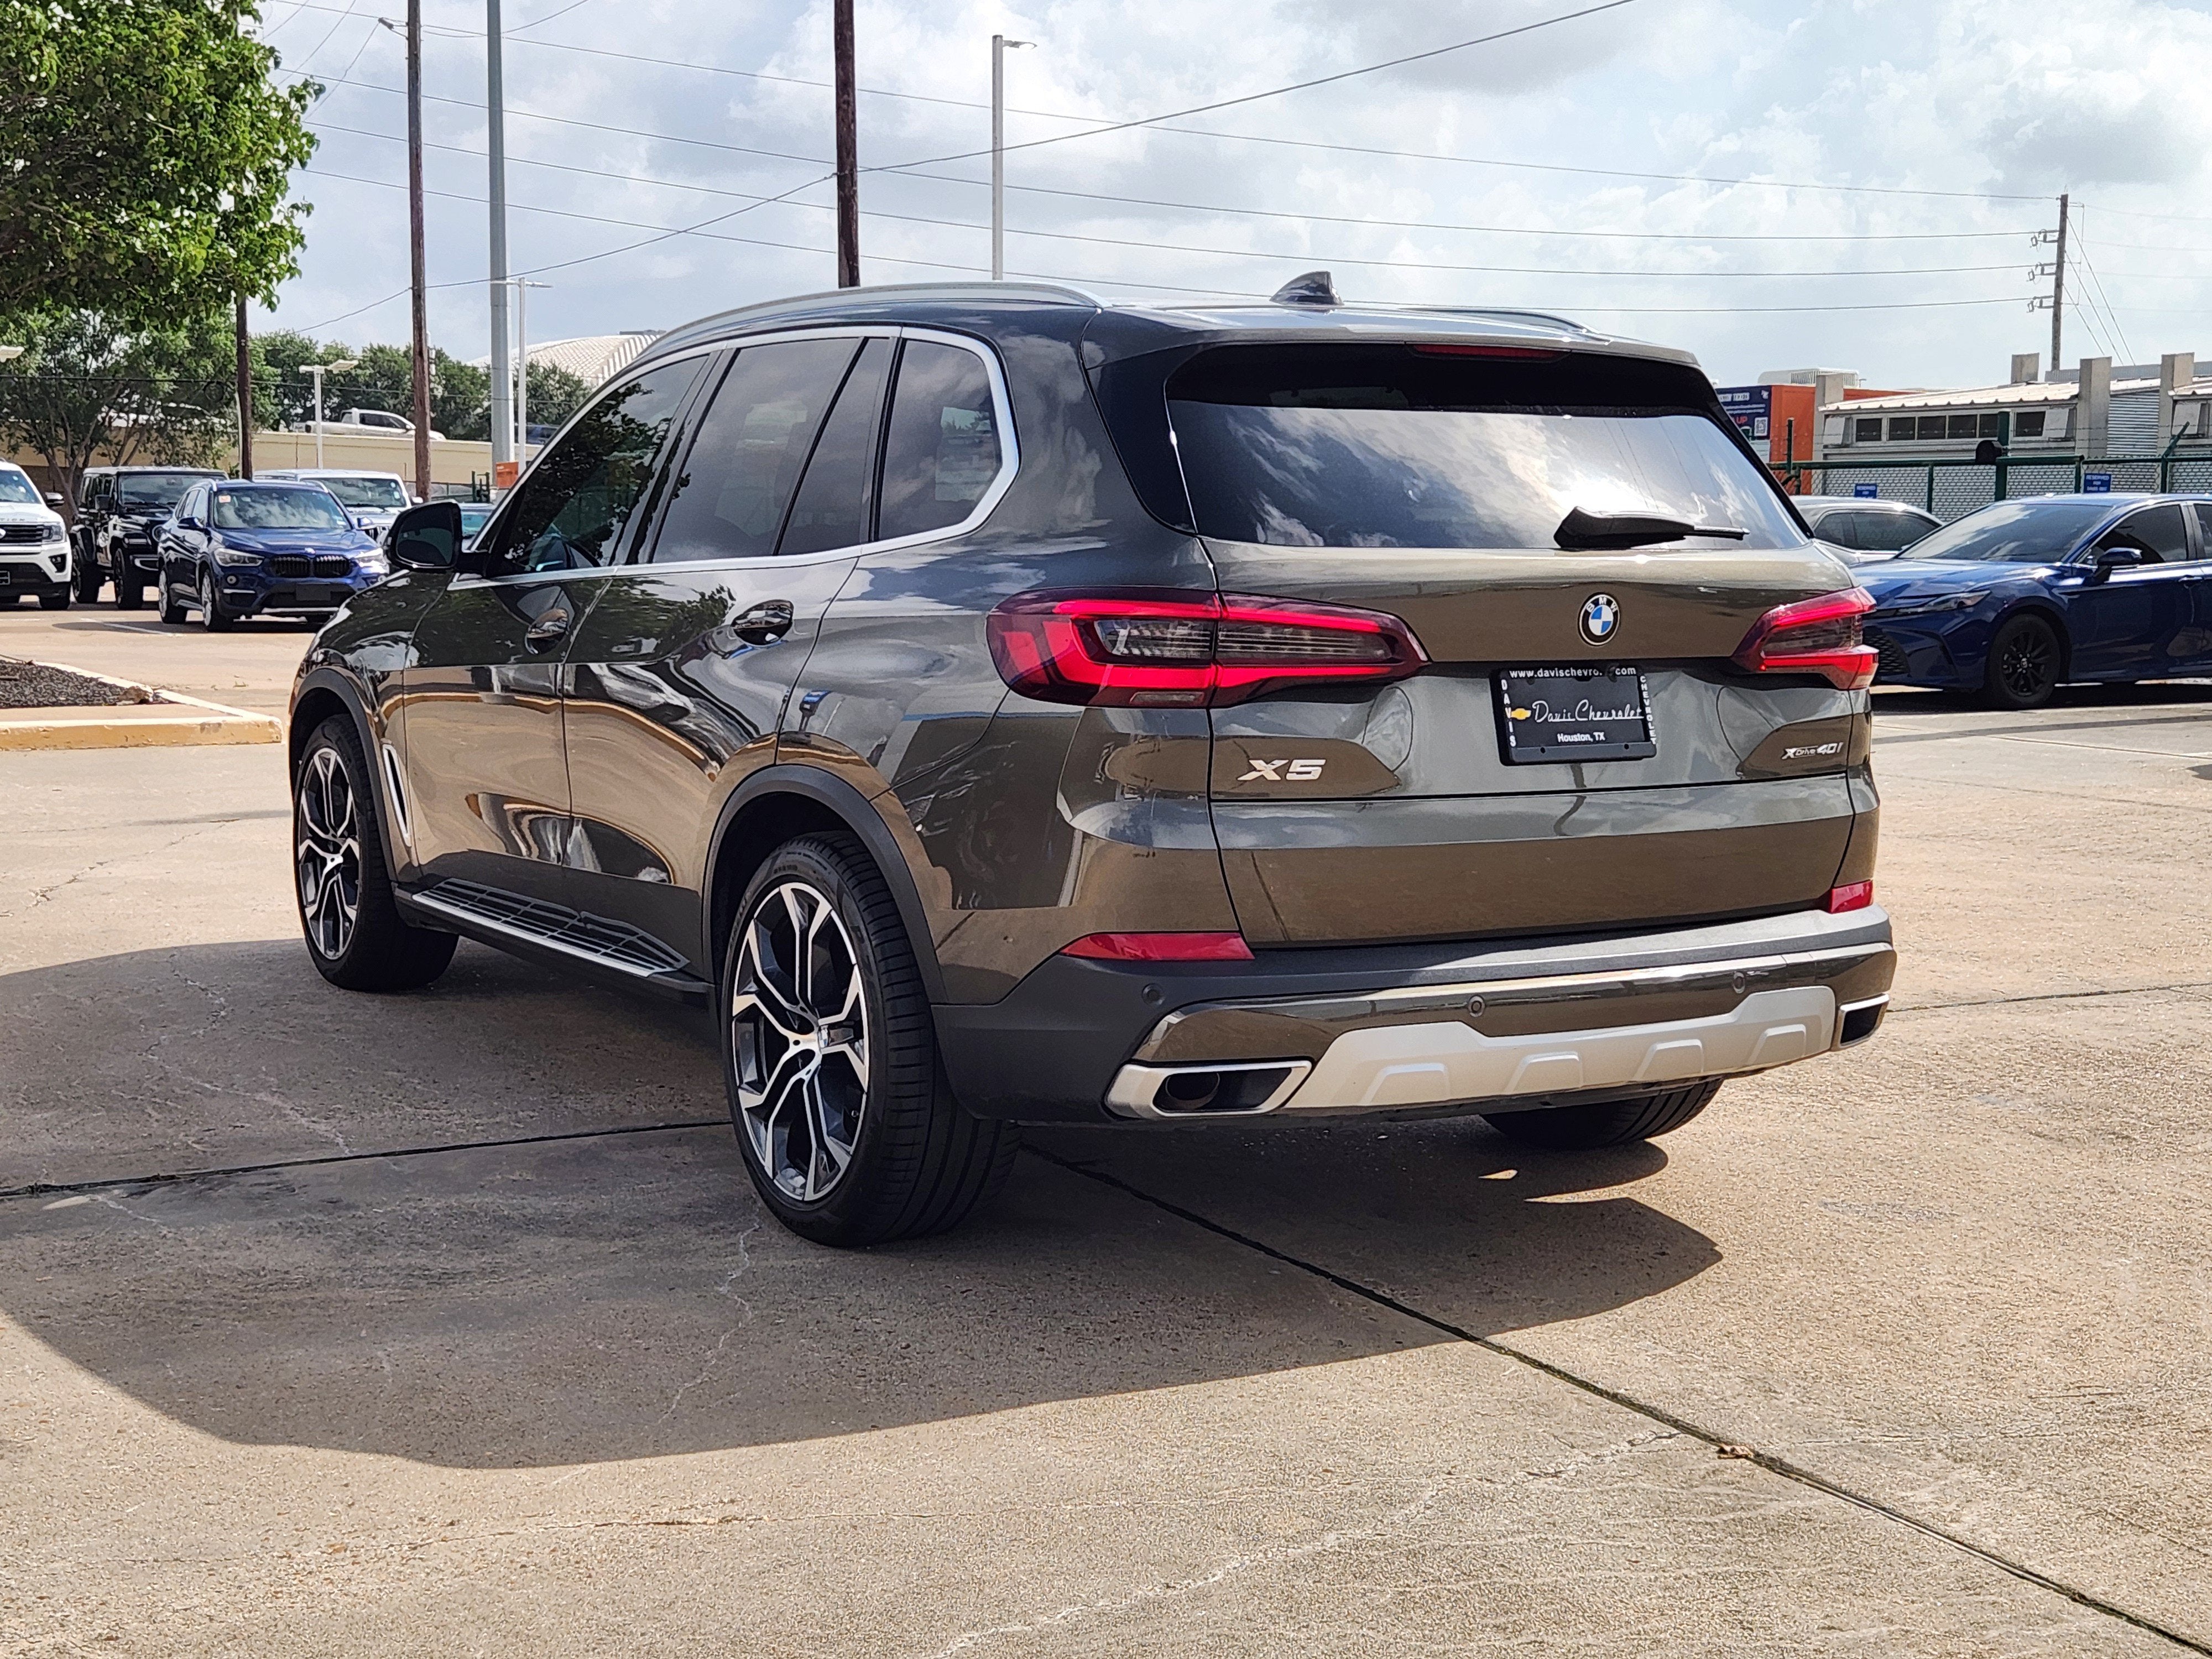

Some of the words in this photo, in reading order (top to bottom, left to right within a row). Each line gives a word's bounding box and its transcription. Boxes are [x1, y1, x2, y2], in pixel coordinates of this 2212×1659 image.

[1586, 597, 1619, 613] BMW
[1501, 679, 1516, 747] DAVIS
[1531, 700, 1575, 722] Davis
[1575, 699, 1644, 721] Chevrolet
[1640, 676, 1657, 744] CHEVROLET
[1557, 732, 1593, 742] Houston,
[1593, 732, 1605, 741] TX
[1237, 759, 1327, 780] X5
